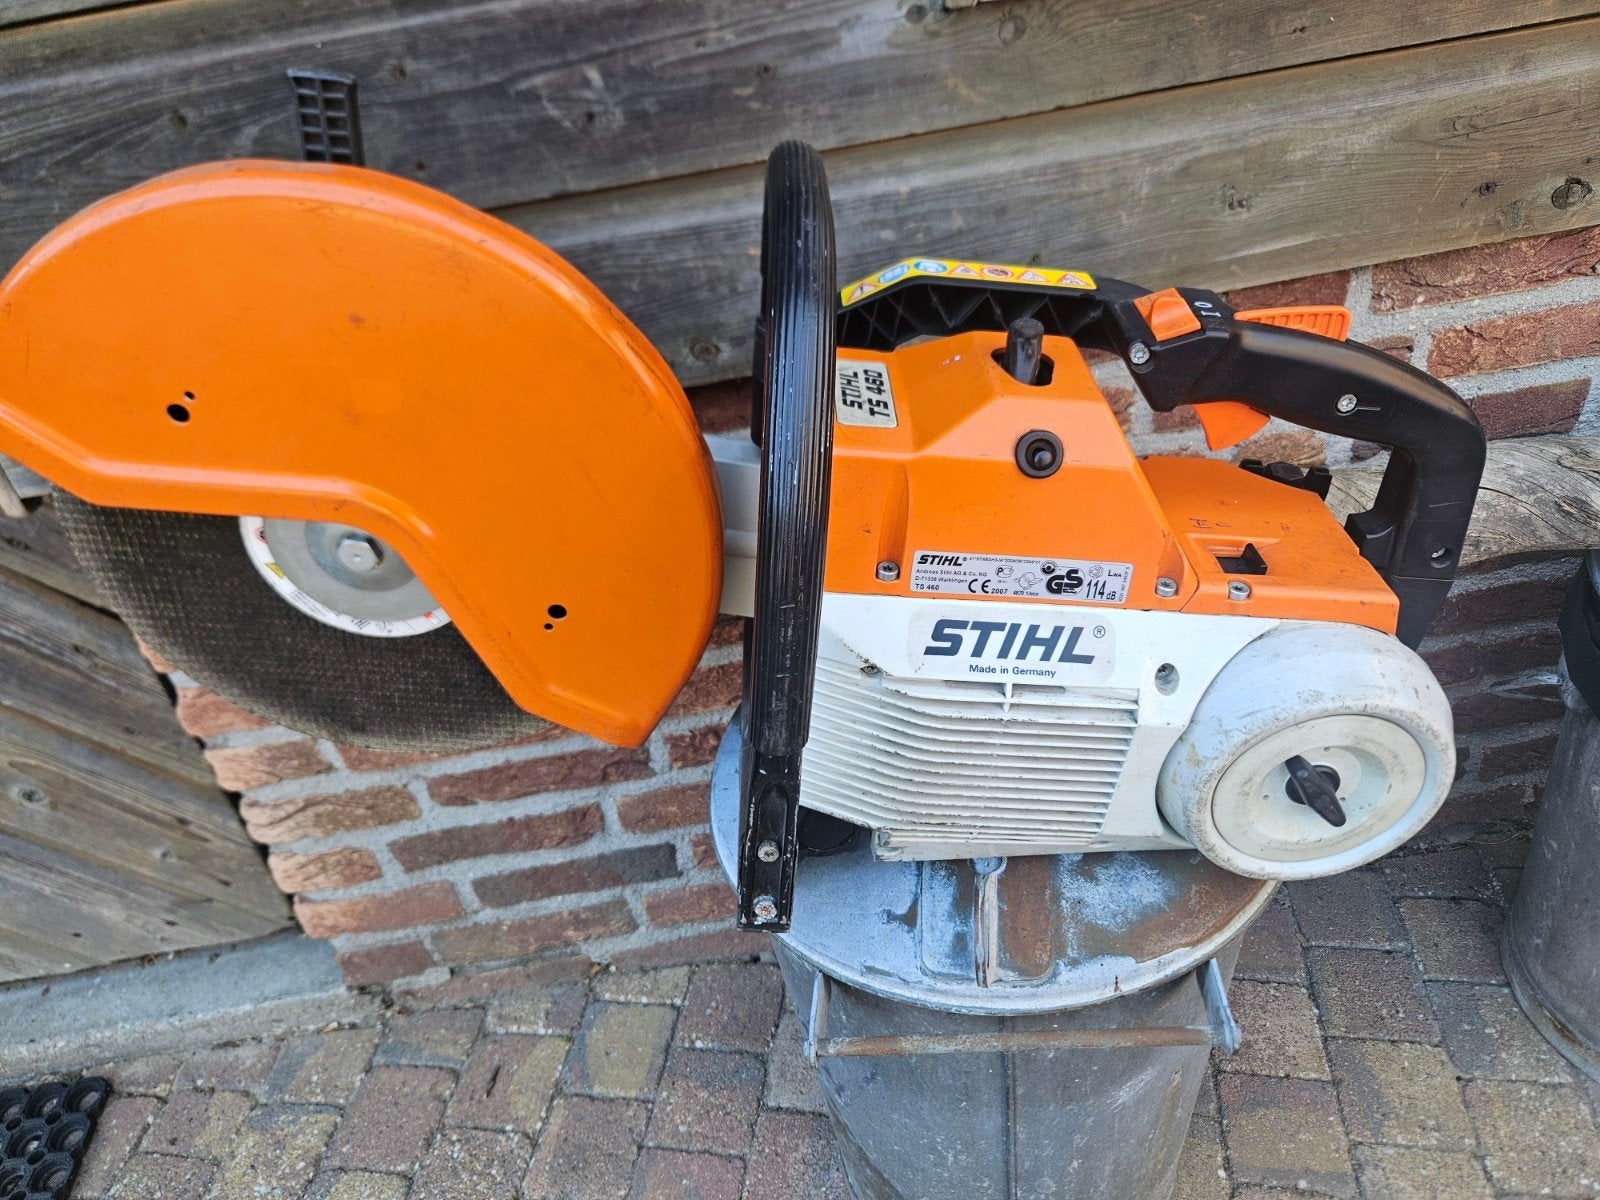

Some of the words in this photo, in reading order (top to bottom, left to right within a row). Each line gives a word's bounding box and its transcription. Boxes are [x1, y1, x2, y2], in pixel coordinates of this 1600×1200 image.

[839, 371, 863, 410] STIHL
[863, 369, 886, 396] 460
[867, 398, 890, 417] TS
[1086, 579, 1107, 600] 114
[1106, 591, 1117, 601] dB
[924, 618, 1096, 665] STIHL
[969, 664, 997, 675] Made
[1000, 665, 1009, 675] in
[1012, 667, 1057, 679] Germany
